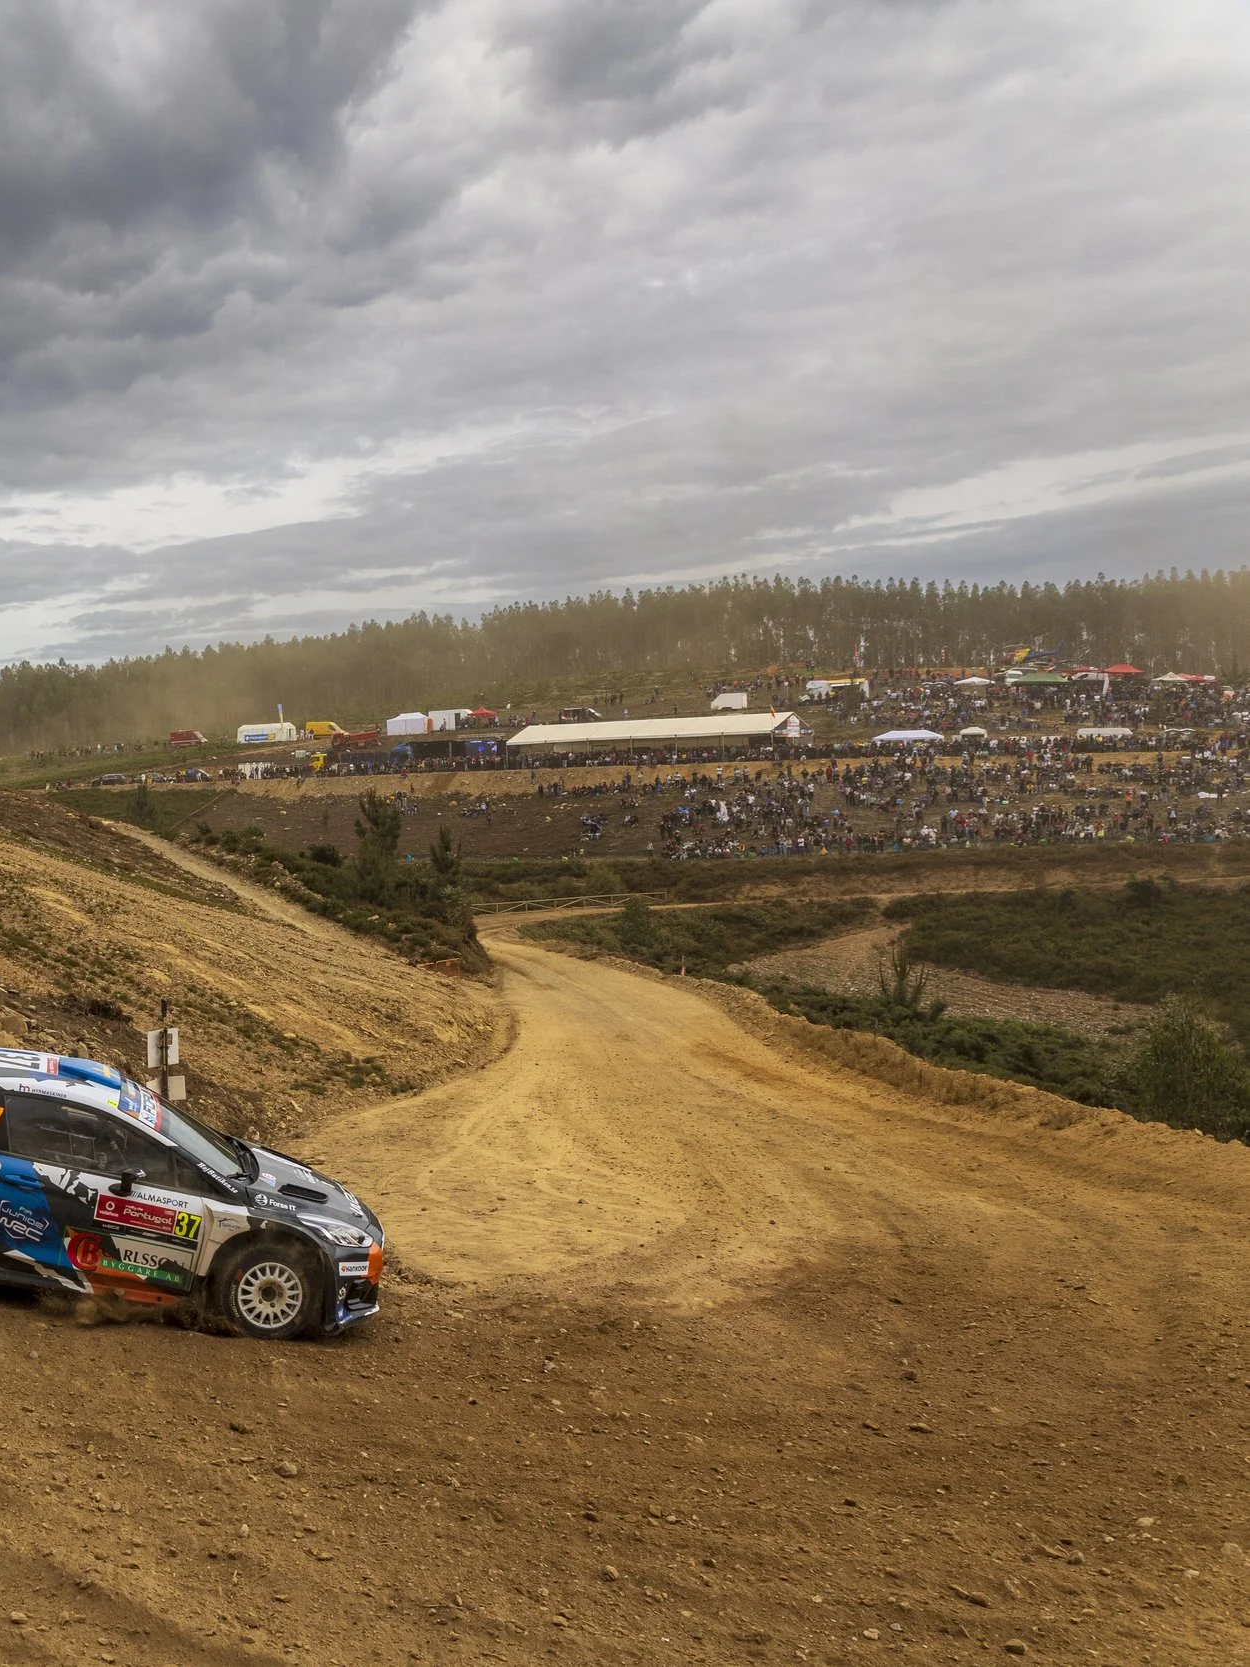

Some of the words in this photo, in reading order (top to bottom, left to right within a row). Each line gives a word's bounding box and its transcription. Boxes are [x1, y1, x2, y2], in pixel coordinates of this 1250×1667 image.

[99, 1209, 119, 1218] vodafone
[269, 1199, 288, 1210] Forss
[289, 1204, 297, 1212] IT
[123, 1207, 173, 1225] Portugal
[175, 1212, 202, 1239] 37
[102, 1259, 158, 1278] BYGGARE
[165, 1273, 181, 1283] AB
